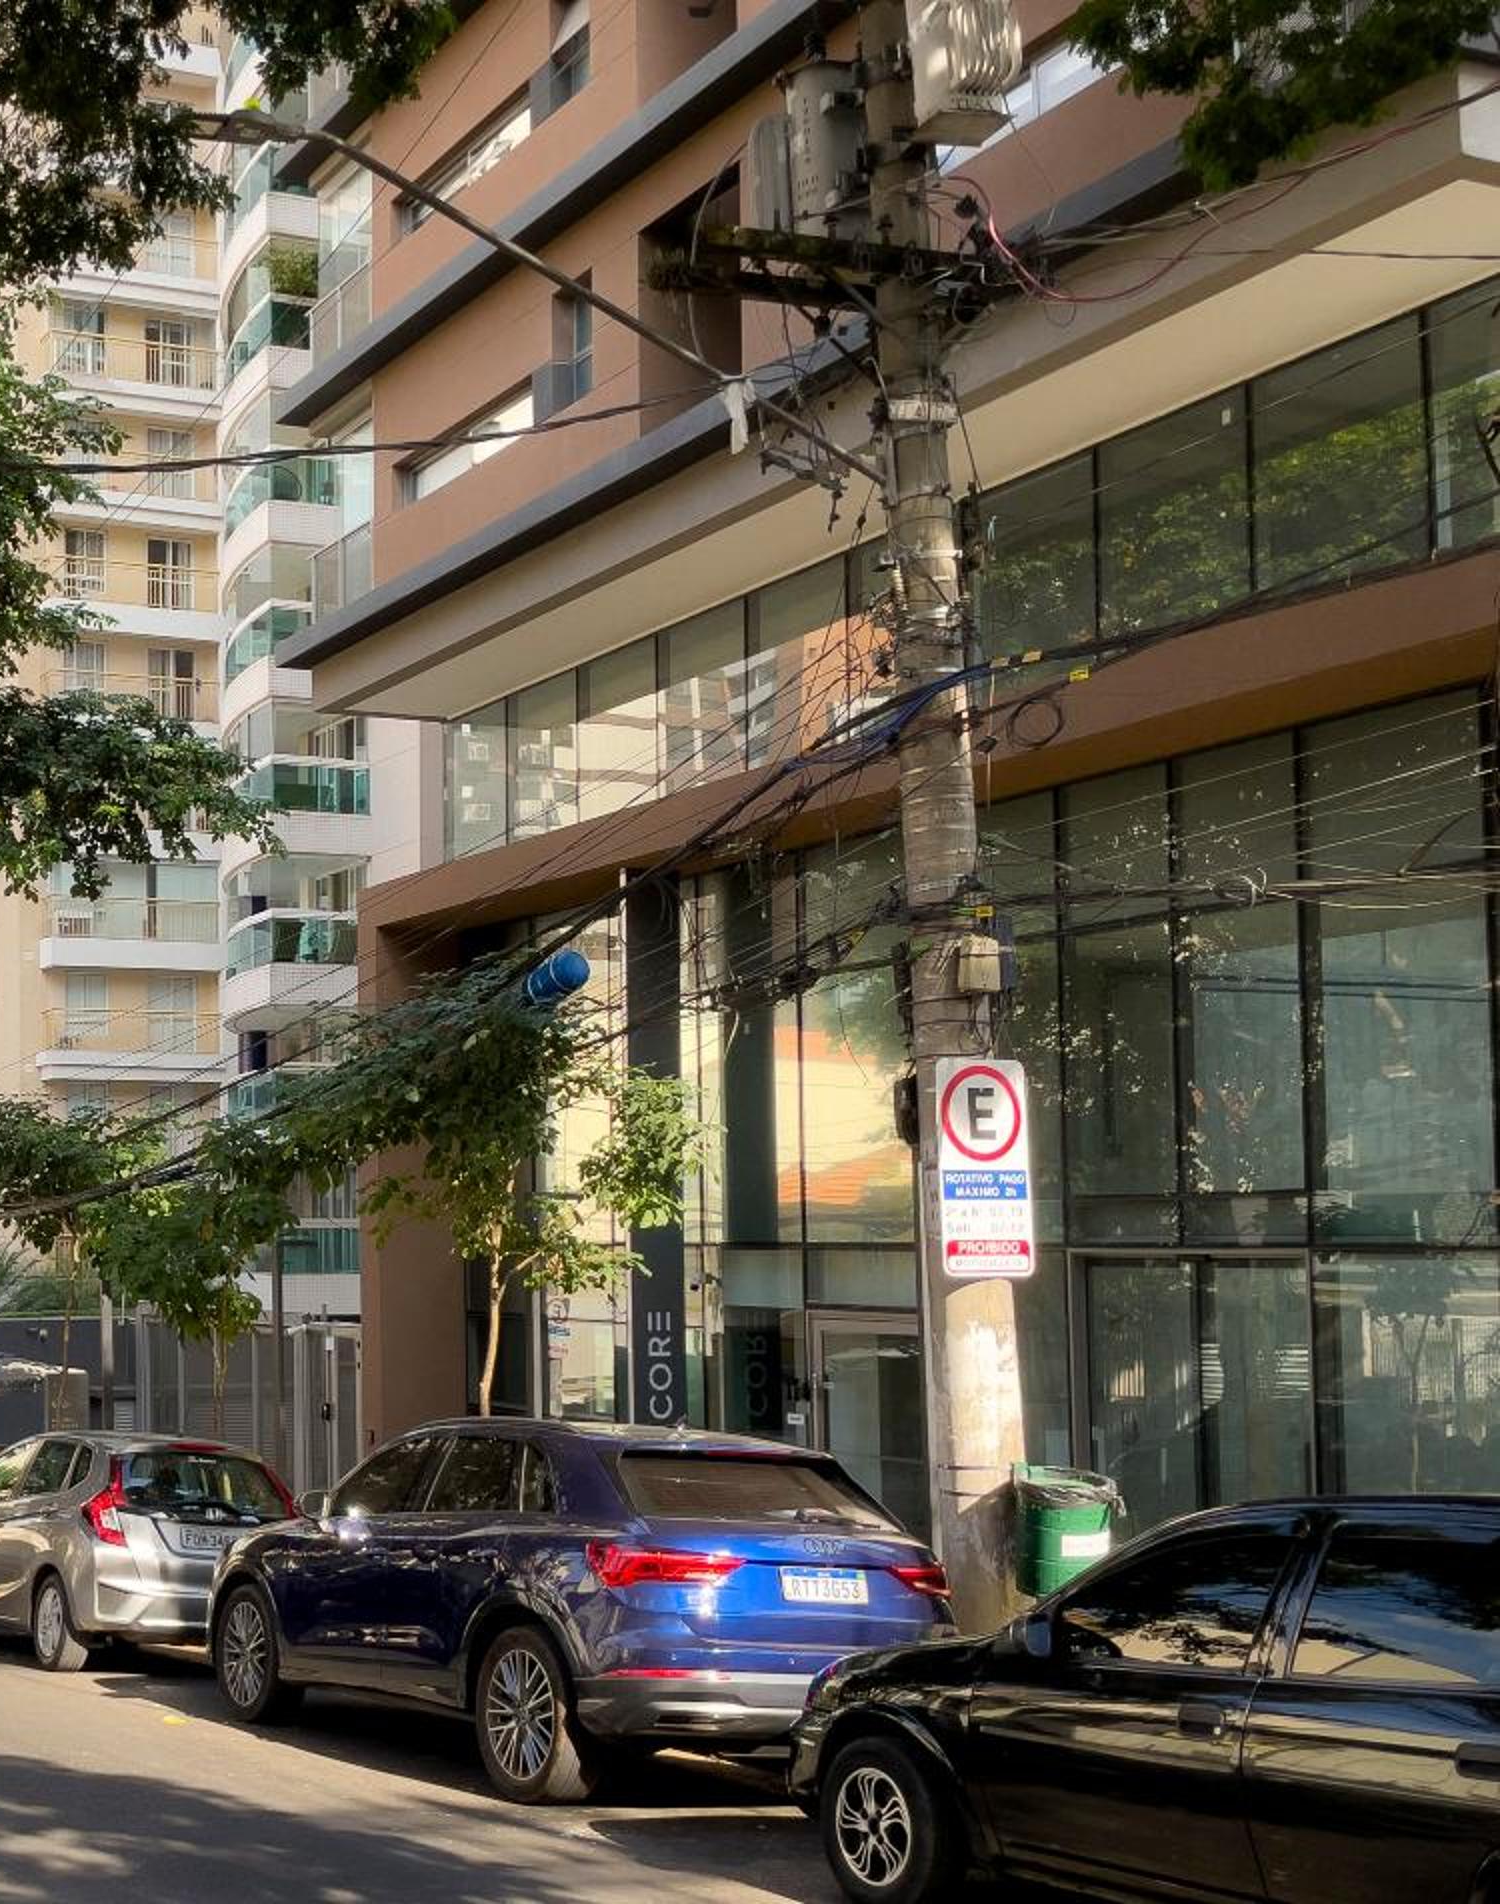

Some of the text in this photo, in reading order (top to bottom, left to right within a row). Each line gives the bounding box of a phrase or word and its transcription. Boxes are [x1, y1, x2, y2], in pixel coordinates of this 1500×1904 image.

[967, 1088, 997, 1139] E
[946, 1173, 1025, 1184] ROTATIVO PAGO
[958, 1241, 1020, 1254] PROIBIDO
[648, 1312, 672, 1419] CORE
